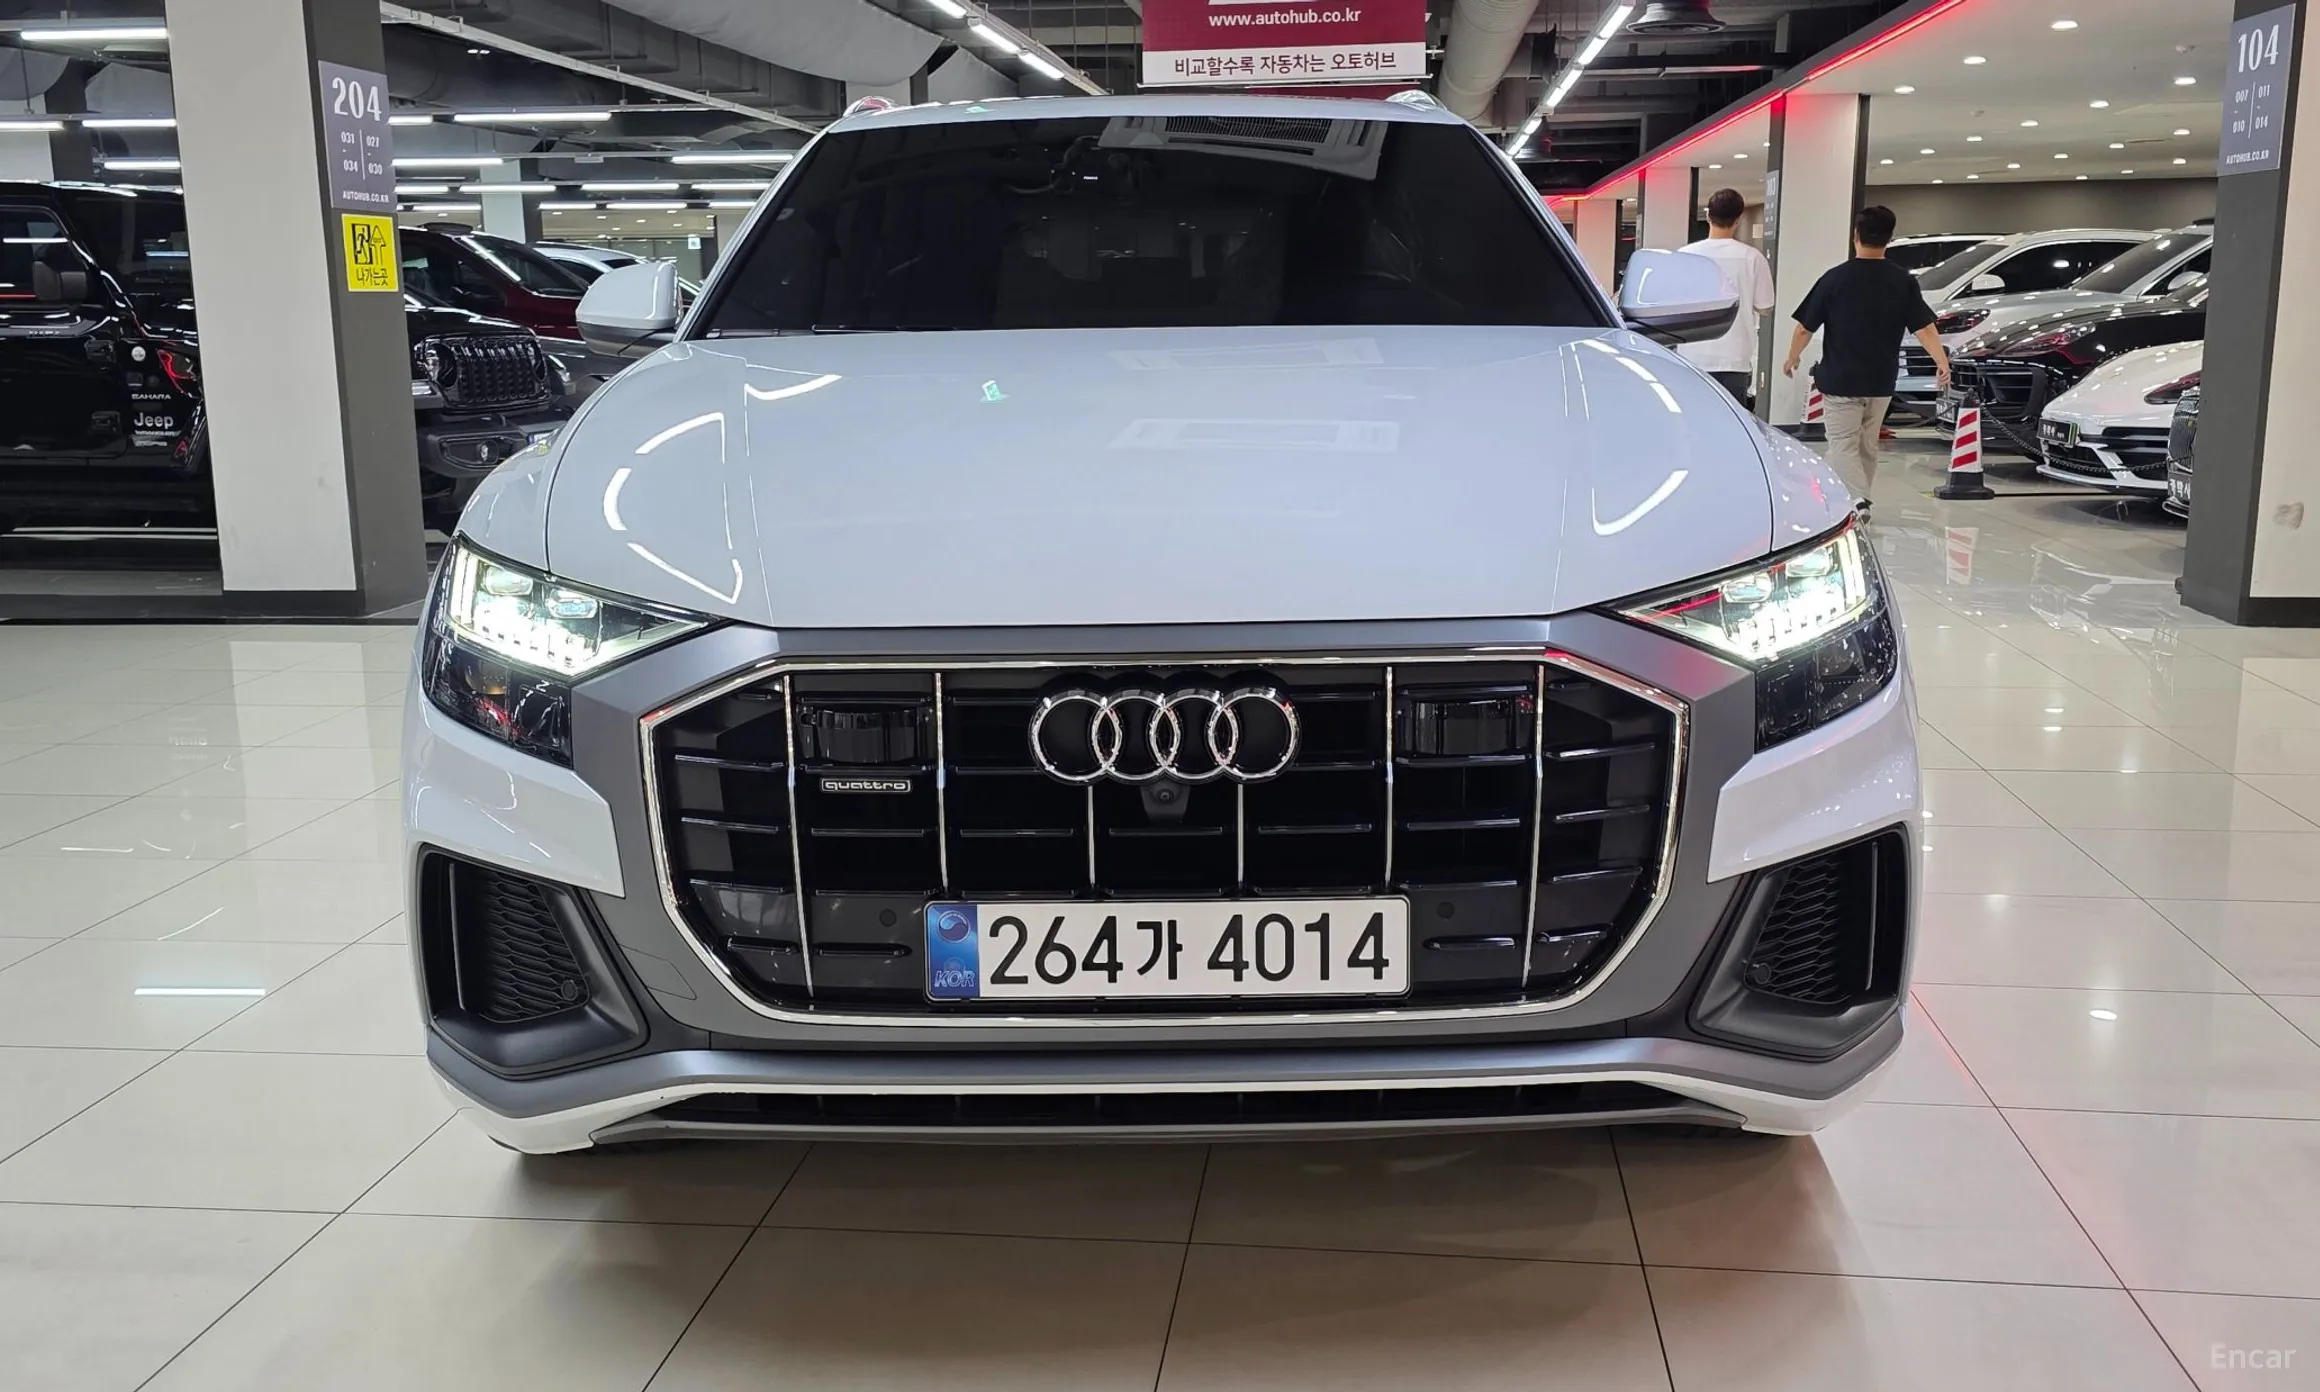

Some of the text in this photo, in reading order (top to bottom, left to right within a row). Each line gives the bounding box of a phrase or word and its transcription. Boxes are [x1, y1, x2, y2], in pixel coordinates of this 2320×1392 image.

[1208, 8, 1362, 27] www.autohub.co.kr
[2238, 24, 2279, 73] 104
[1175, 51, 1397, 77] 비교할수록 자동차는 오토허브
[332, 76, 382, 122] 204
[341, 131, 355, 144] 031
[343, 159, 358, 172] 034
[2226, 149, 2270, 165] AUTOHUB.CO.KR
[368, 162, 383, 175] 030
[342, 190, 389, 203] AUTOHUB.CO.KR
[356, 267, 389, 286] 나가는곳
[133, 411, 174, 430] Jeep
[825, 781, 906, 791] quattro
[988, 911, 1390, 985] 264가 4014
[934, 970, 976, 988] KOR
